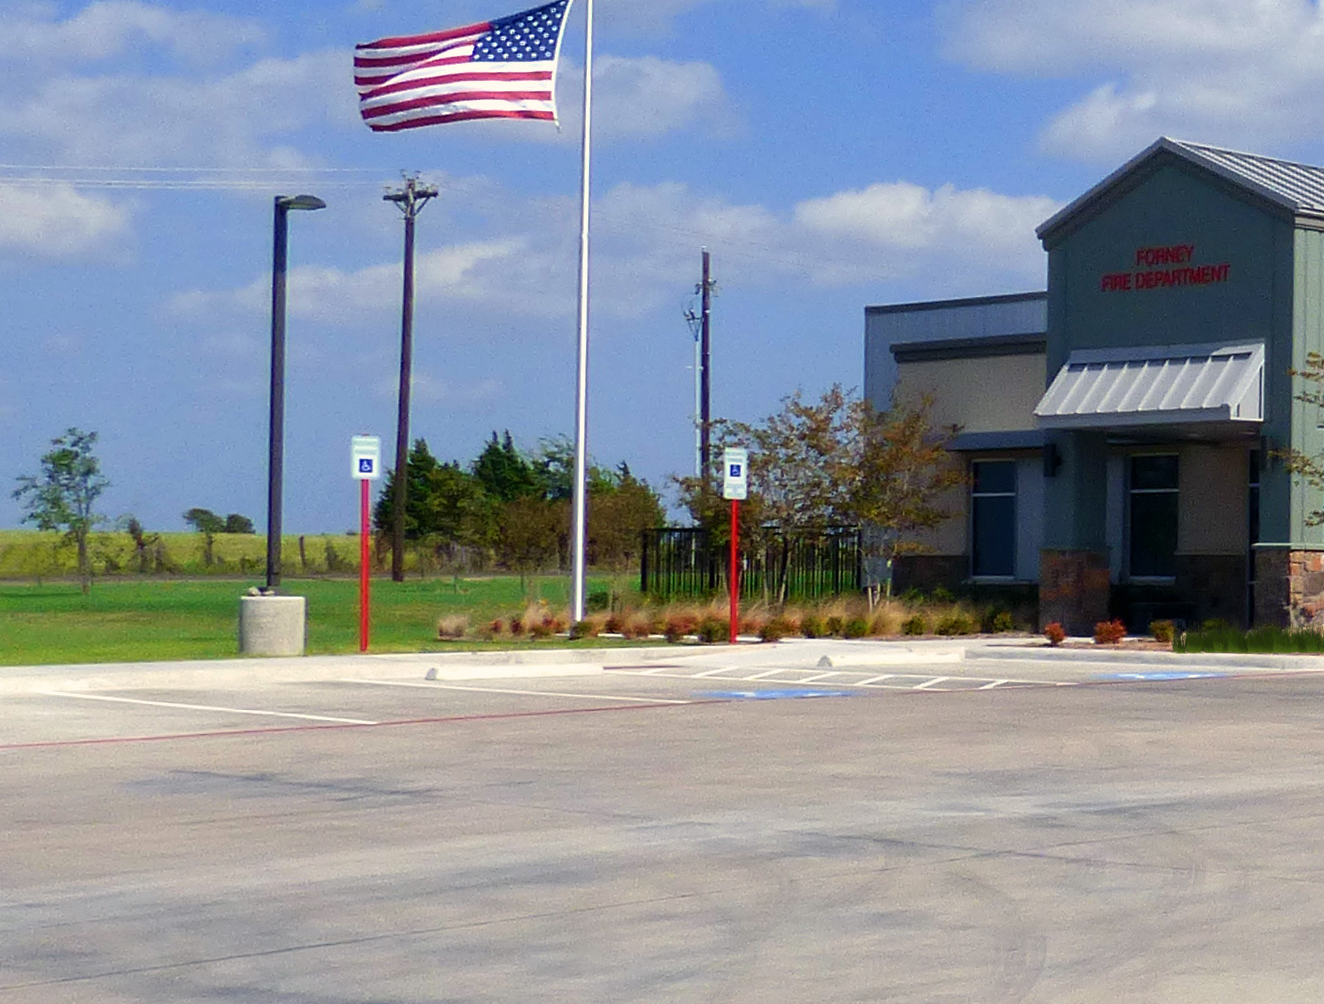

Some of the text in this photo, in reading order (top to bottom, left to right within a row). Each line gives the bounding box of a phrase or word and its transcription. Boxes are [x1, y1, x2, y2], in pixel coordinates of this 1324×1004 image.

[1136, 244, 1194, 266] FORNEY
[1101, 263, 1230, 292] FIRE DEPARTMENT
